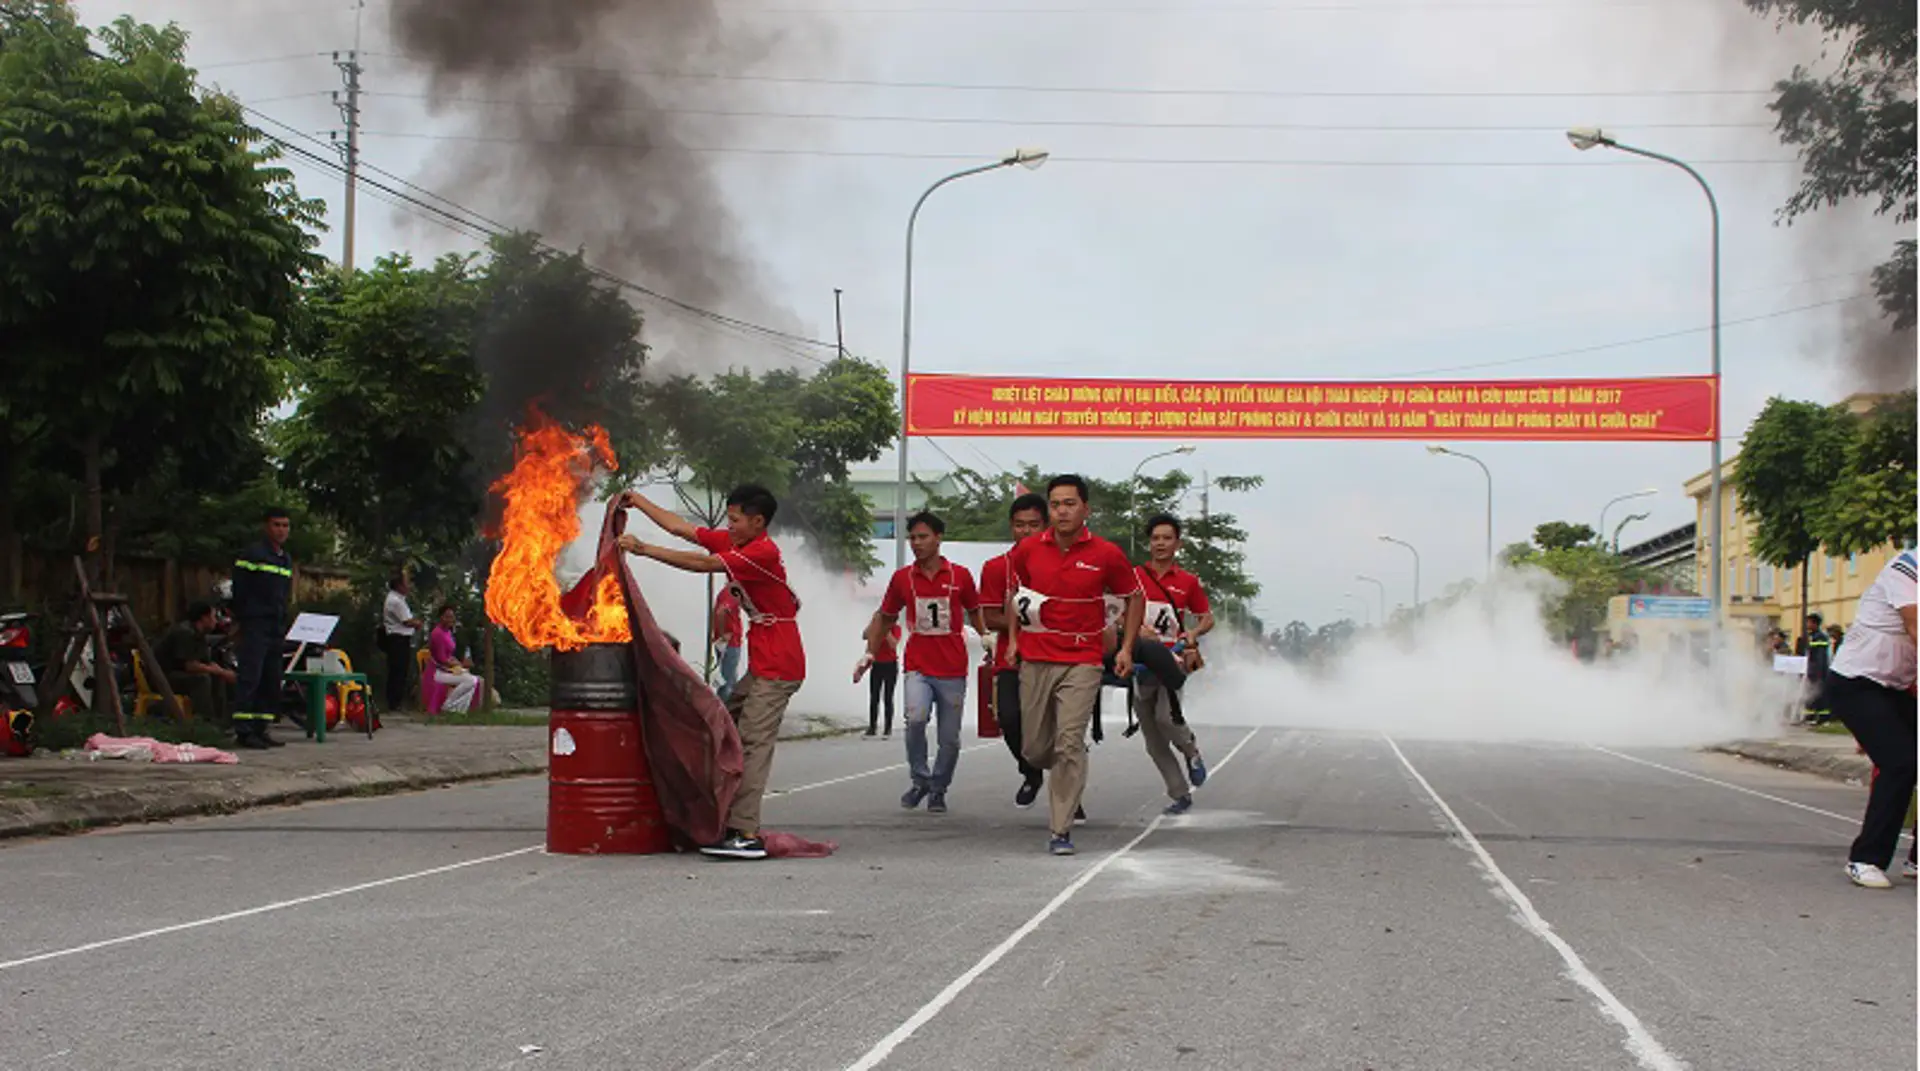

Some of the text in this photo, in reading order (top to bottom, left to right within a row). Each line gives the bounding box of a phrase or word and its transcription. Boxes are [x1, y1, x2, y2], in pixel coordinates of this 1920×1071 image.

[1257, 388, 1285, 403] THAM
[1287, 388, 1304, 403] GIA
[1438, 386, 1462, 403] CHÁY
[1596, 388, 1623, 404] 2017
[1275, 410, 1301, 426] CHÁY
[927, 603, 940, 628] 1
[1018, 596, 1031, 627] 3
[1153, 607, 1170, 636] 4
